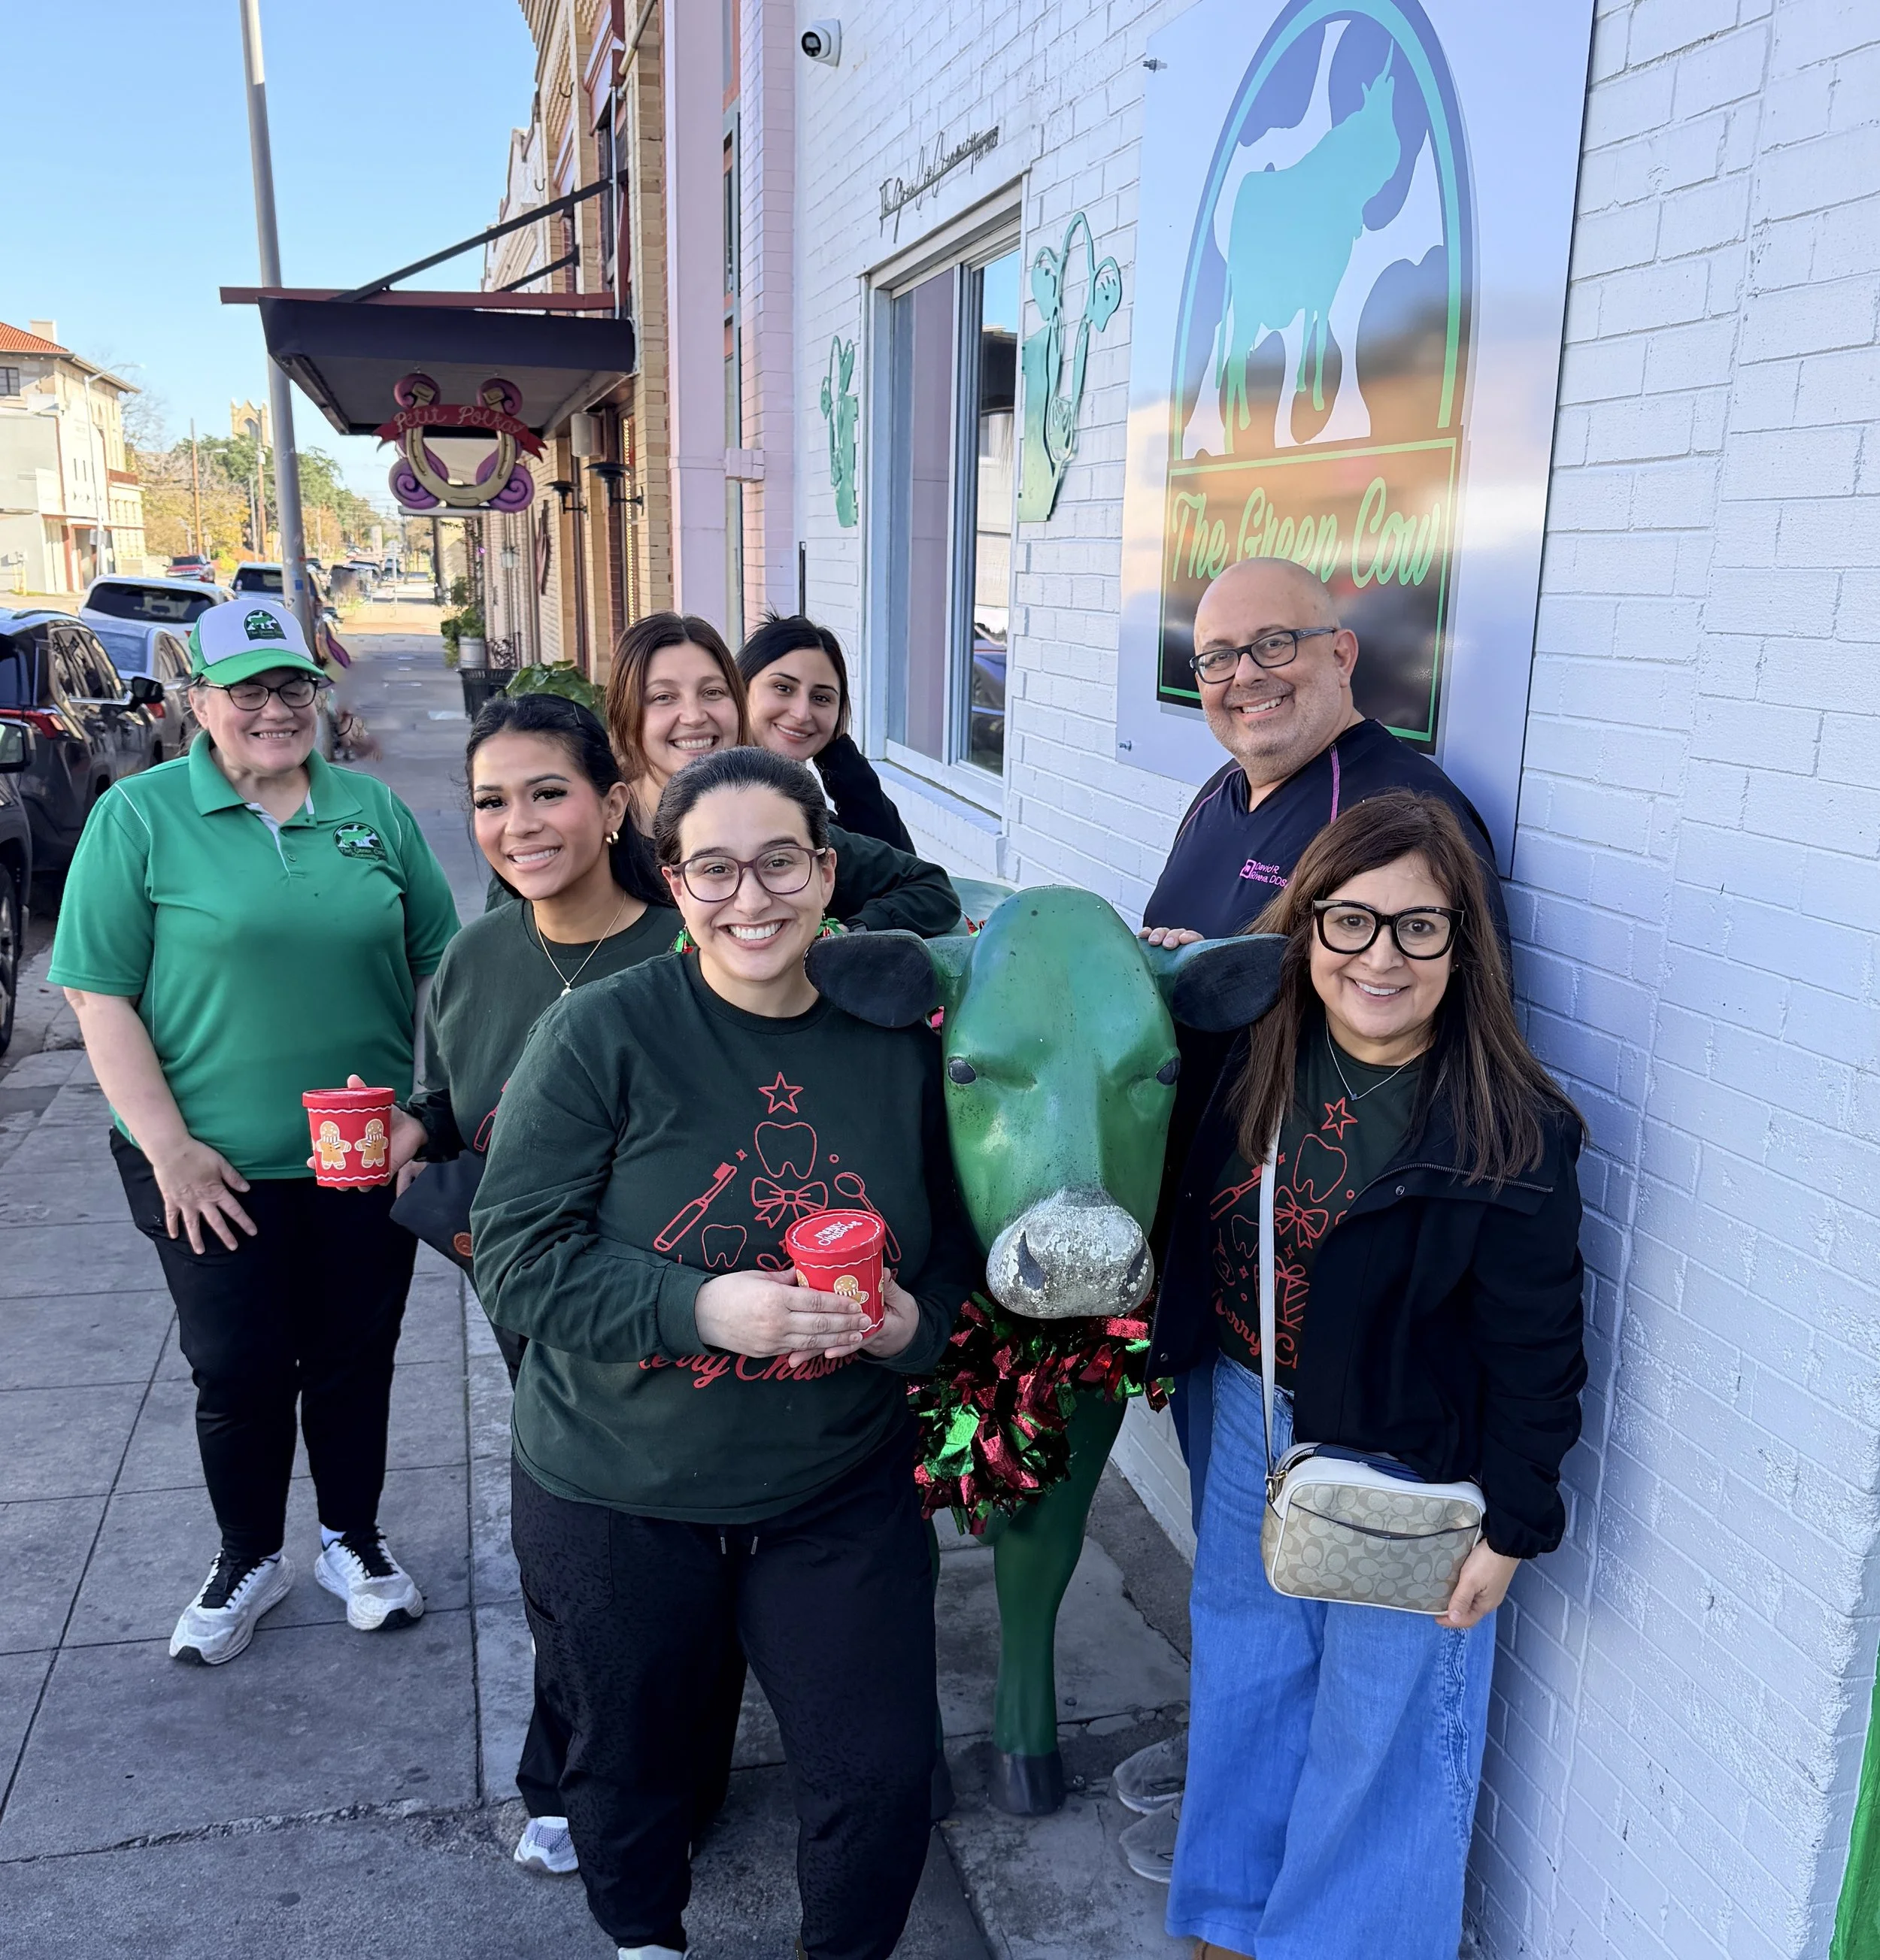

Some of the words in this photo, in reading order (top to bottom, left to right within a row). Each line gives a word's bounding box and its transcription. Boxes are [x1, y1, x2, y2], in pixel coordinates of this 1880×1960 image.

[393, 407, 447, 433] Petit
[1172, 491, 1230, 582] The
[1236, 486, 1342, 583] Green
[1351, 476, 1440, 589] Cow
[1254, 862, 1274, 873] David
